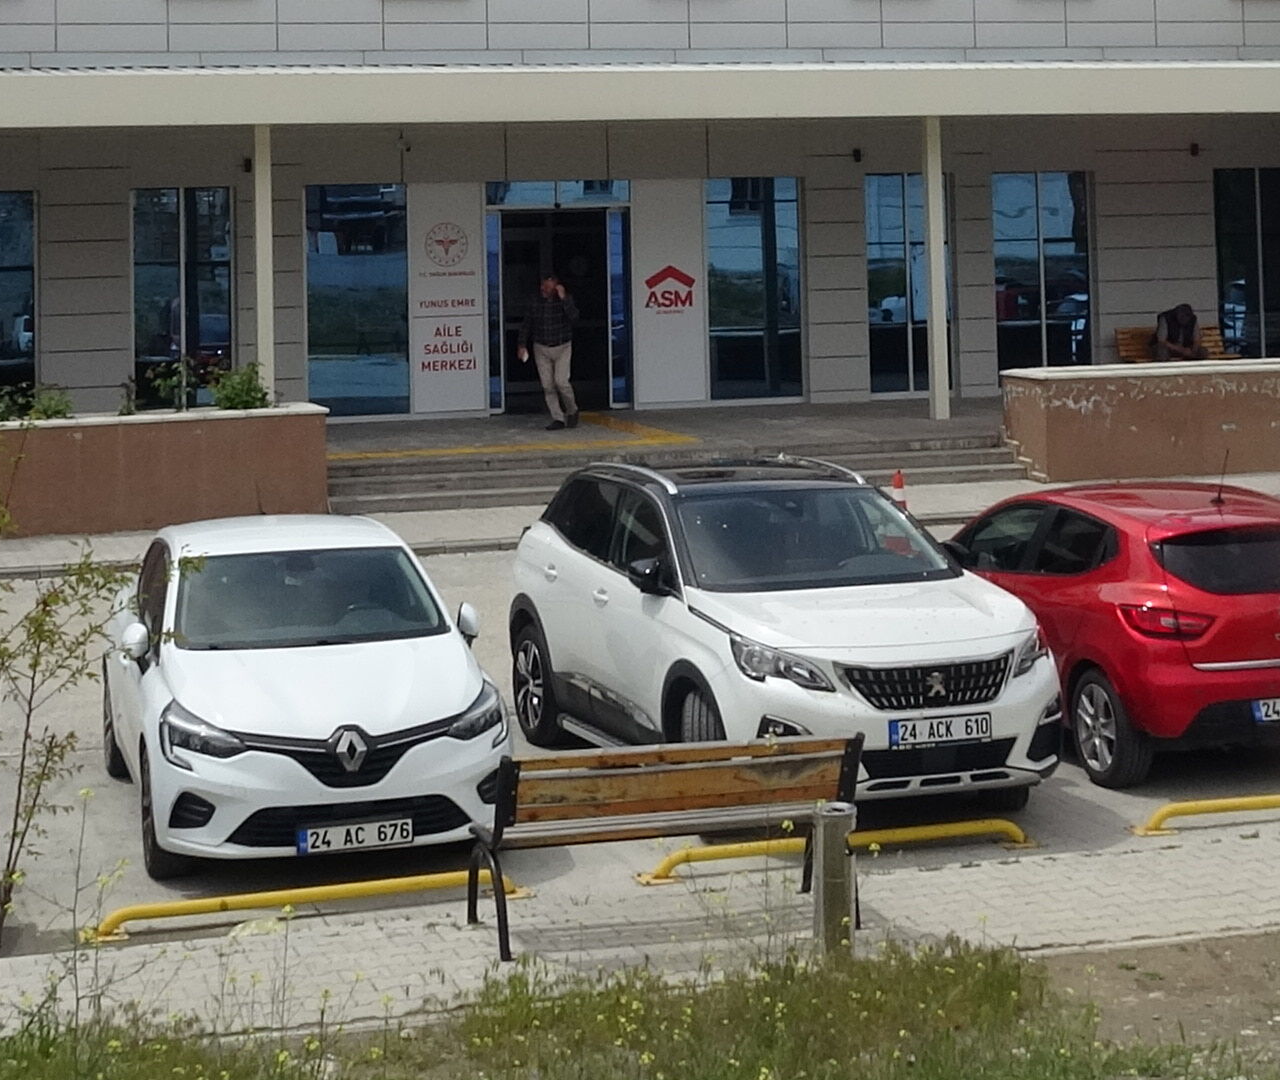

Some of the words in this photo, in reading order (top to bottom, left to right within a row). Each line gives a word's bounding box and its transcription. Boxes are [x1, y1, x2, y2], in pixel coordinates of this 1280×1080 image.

[420, 299, 449, 309] YUNUS
[451, 298, 476, 308] EMRE
[645, 290, 693, 308] ASM
[434, 323, 462, 337] AİLE
[424, 340, 473, 355] SAĞLIĞI
[421, 356, 476, 372] MERKEZİ
[1262, 701, 1280, 718] 24
[900, 723, 917, 741] 24
[928, 721, 953, 739] ACK
[965, 717, 989, 736] 610
[310, 830, 331, 850] 24
[344, 827, 365, 846] AC
[377, 822, 410, 842] 676
